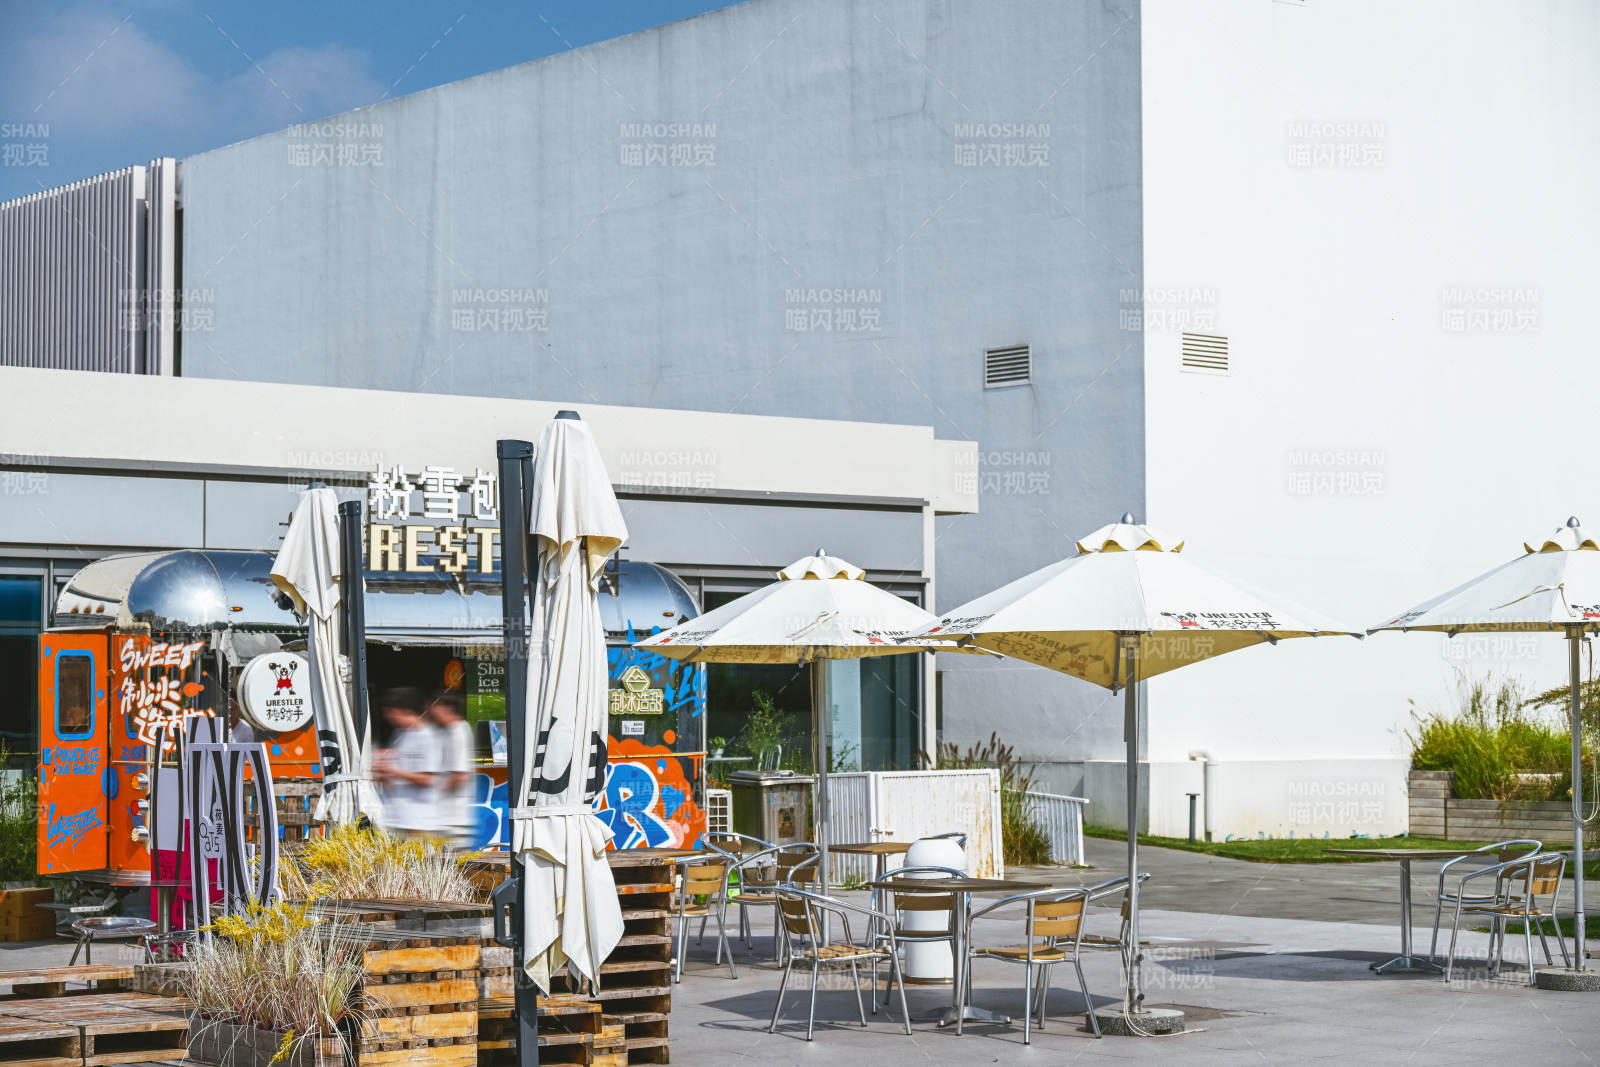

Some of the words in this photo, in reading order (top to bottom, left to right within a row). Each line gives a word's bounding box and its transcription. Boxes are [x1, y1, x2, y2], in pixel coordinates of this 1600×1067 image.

[367, 524, 500, 573] REST
[120, 638, 205, 672] SWEET
[478, 662, 504, 676] Sha
[479, 676, 500, 687] ice
[611, 691, 662, 712] 制冰造甜
